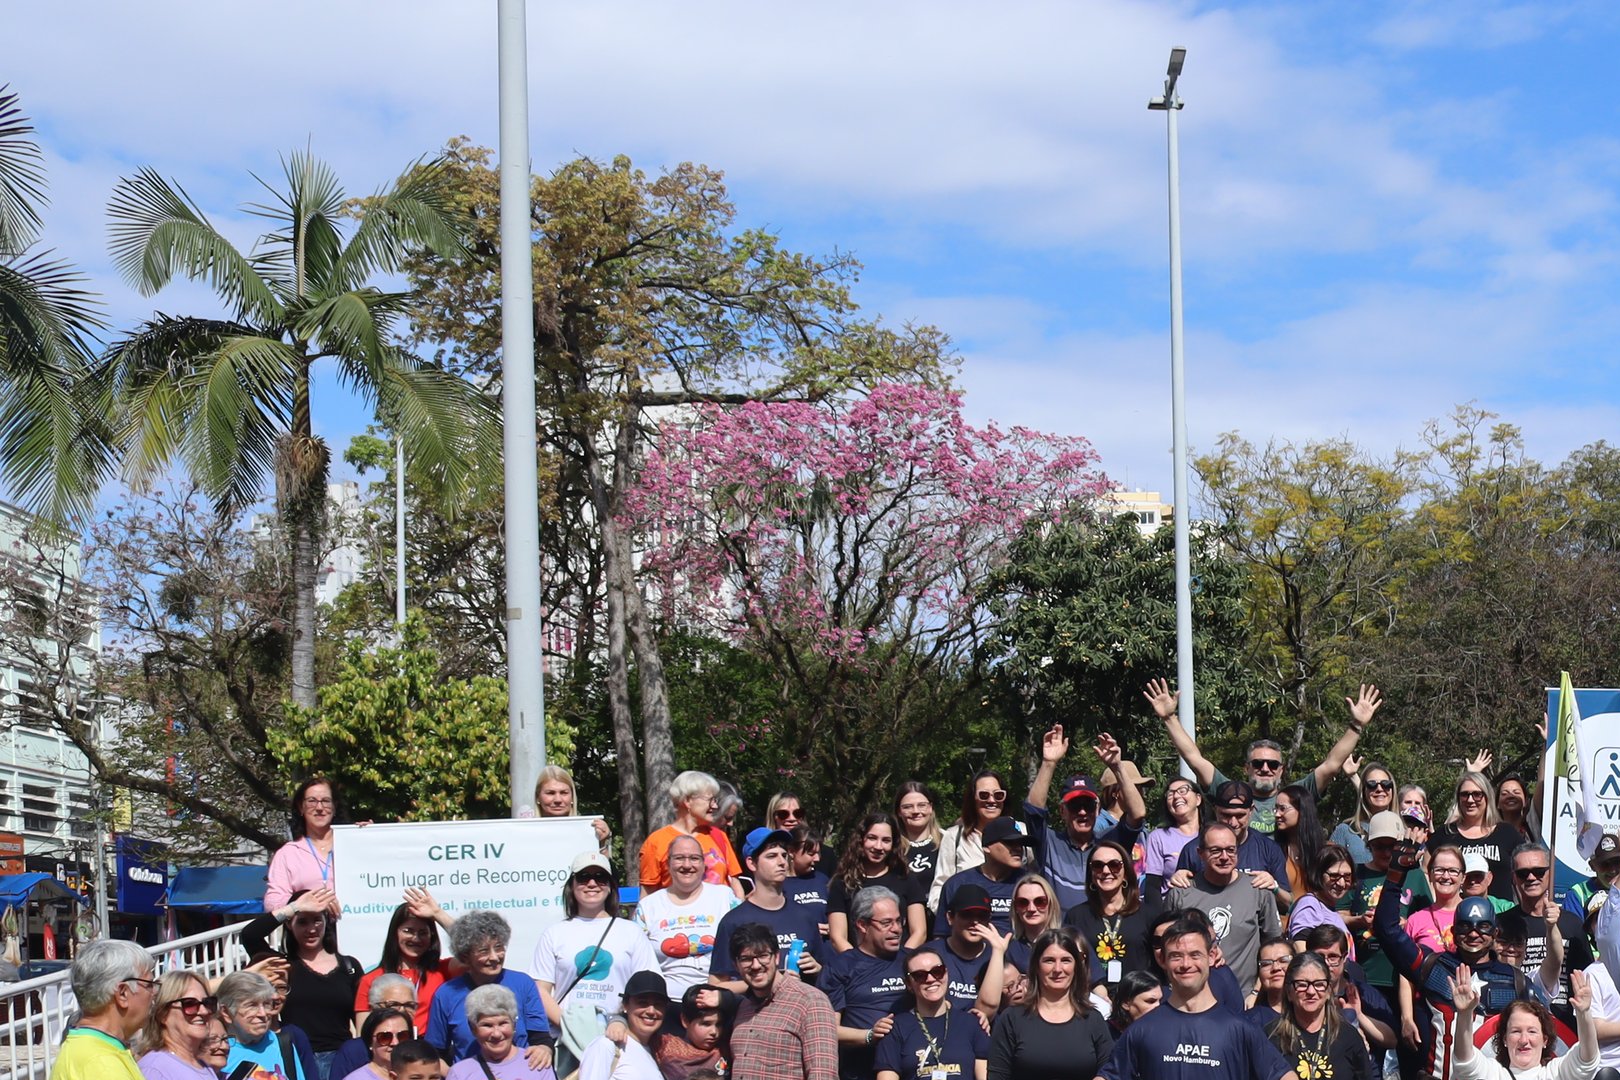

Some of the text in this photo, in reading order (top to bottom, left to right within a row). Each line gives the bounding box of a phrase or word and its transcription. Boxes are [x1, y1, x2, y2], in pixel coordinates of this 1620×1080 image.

[428, 843, 504, 861] CER IV
[402, 871, 444, 889] lugar
[450, 870, 471, 885] de
[793, 891, 819, 901] APAE
[990, 898, 1012, 907] PAE
[342, 903, 398, 914] Auditiv
[464, 897, 537, 910] intelectual
[541, 898, 549, 907] e
[1468, 905, 1482, 918] A
[659, 914, 715, 929] AUTISMO
[776, 933, 798, 943] PAE
[589, 983, 614, 992] SOLUÇÃO
[882, 977, 904, 986] APA
[949, 980, 976, 993] APAE
[1175, 1043, 1210, 1056] APAE
[1163, 1055, 1220, 1067] Novo Hamburgo
